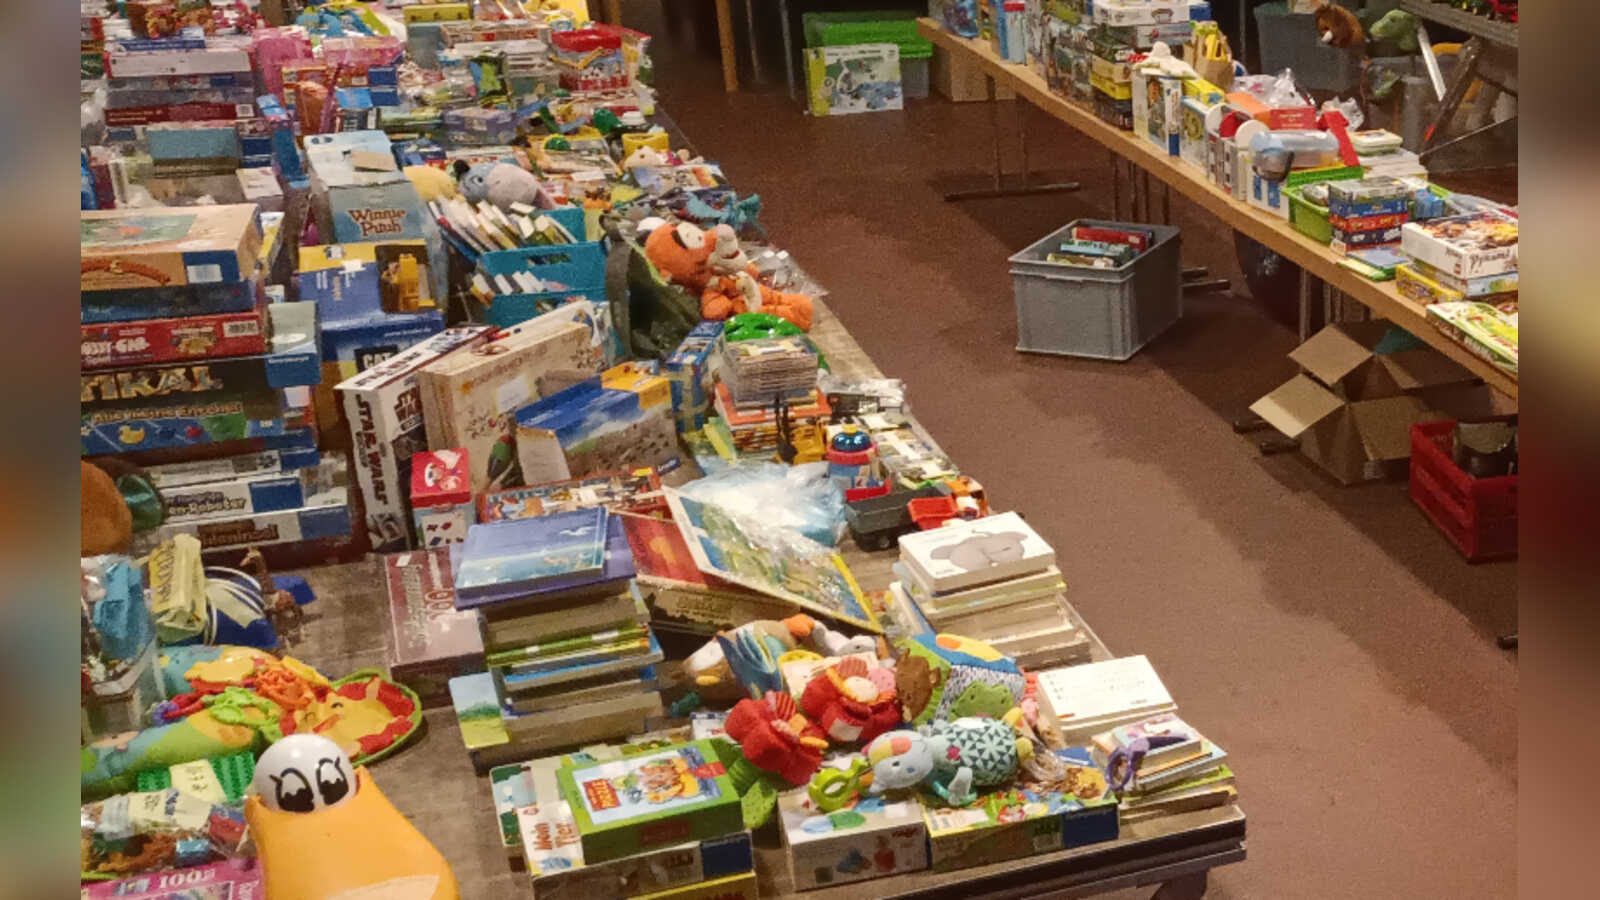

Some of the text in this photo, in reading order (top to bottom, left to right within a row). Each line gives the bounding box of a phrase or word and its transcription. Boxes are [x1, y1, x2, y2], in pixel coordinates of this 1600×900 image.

[347, 208, 407, 222] Winnie
[355, 393, 378, 448] STAR
[367, 451, 389, 505] WARS
